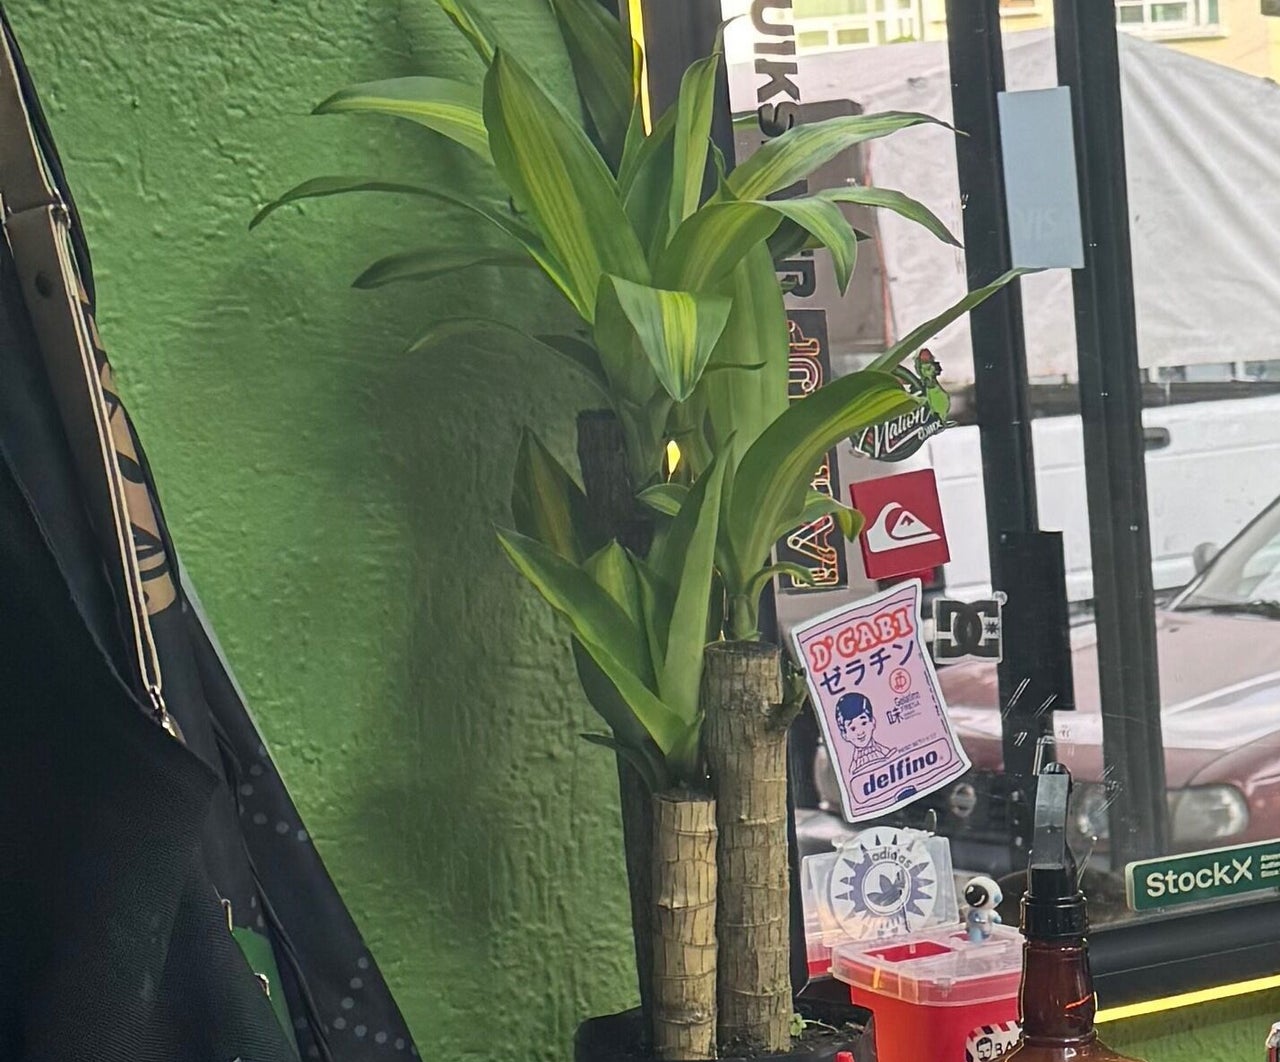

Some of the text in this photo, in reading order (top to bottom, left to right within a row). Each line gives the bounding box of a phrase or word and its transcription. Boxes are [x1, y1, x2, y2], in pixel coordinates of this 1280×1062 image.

[811, 606, 914, 673] D'GABI
[820, 640, 915, 695] ゼラチン
[862, 749, 938, 797] delfino
[1146, 855, 1253, 898] StockX
